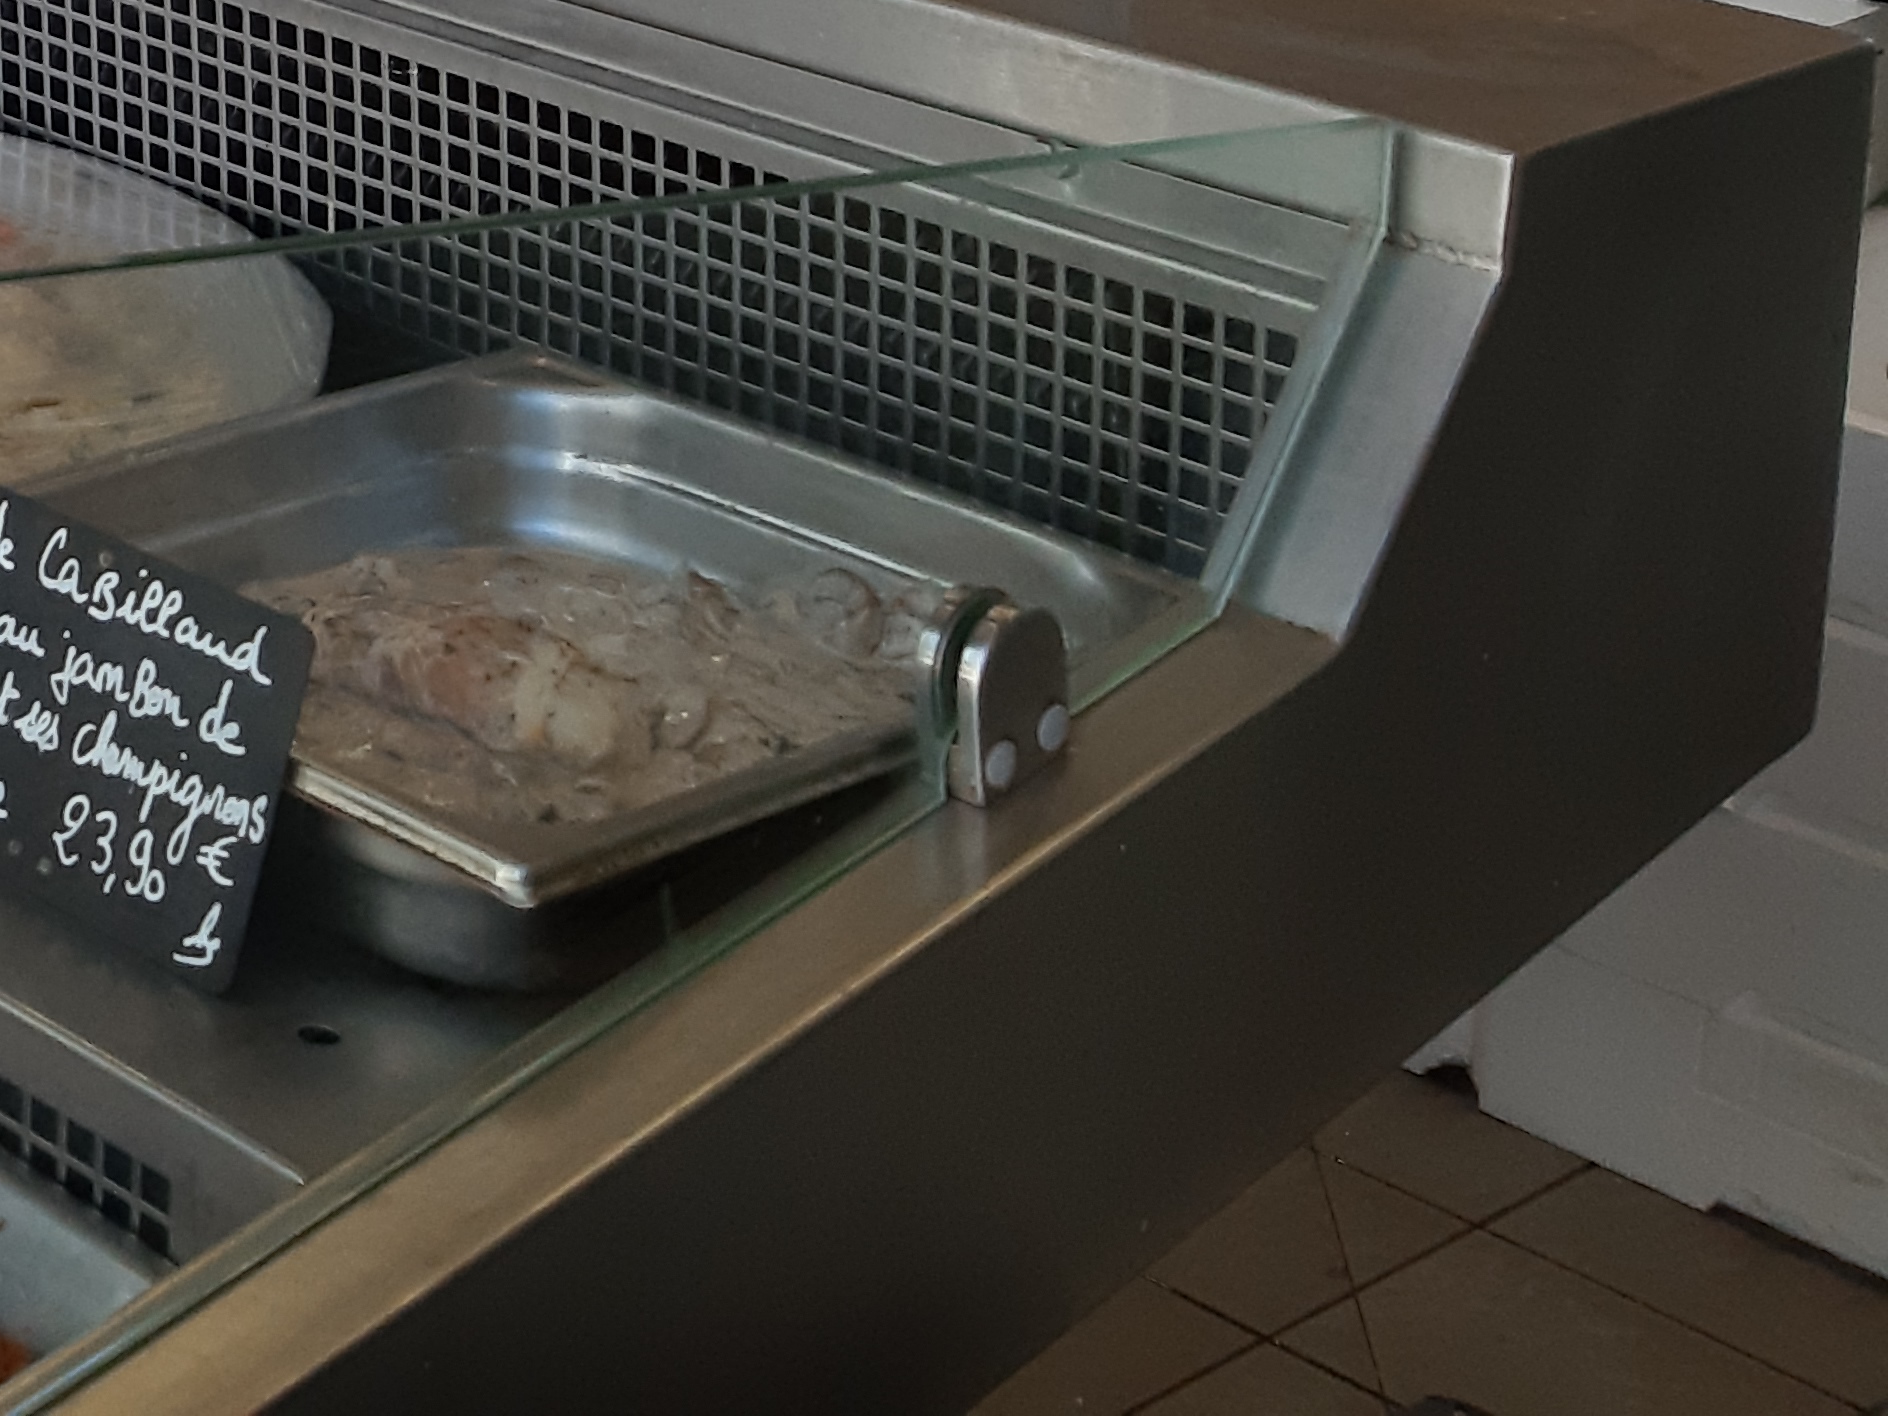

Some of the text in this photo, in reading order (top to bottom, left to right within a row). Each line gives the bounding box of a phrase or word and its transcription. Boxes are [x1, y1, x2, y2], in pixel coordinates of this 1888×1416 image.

[14, 701, 60, 753] ses
[197, 679, 246, 755] de
[52, 793, 167, 903] 23,90
[196, 835, 240, 888] €
